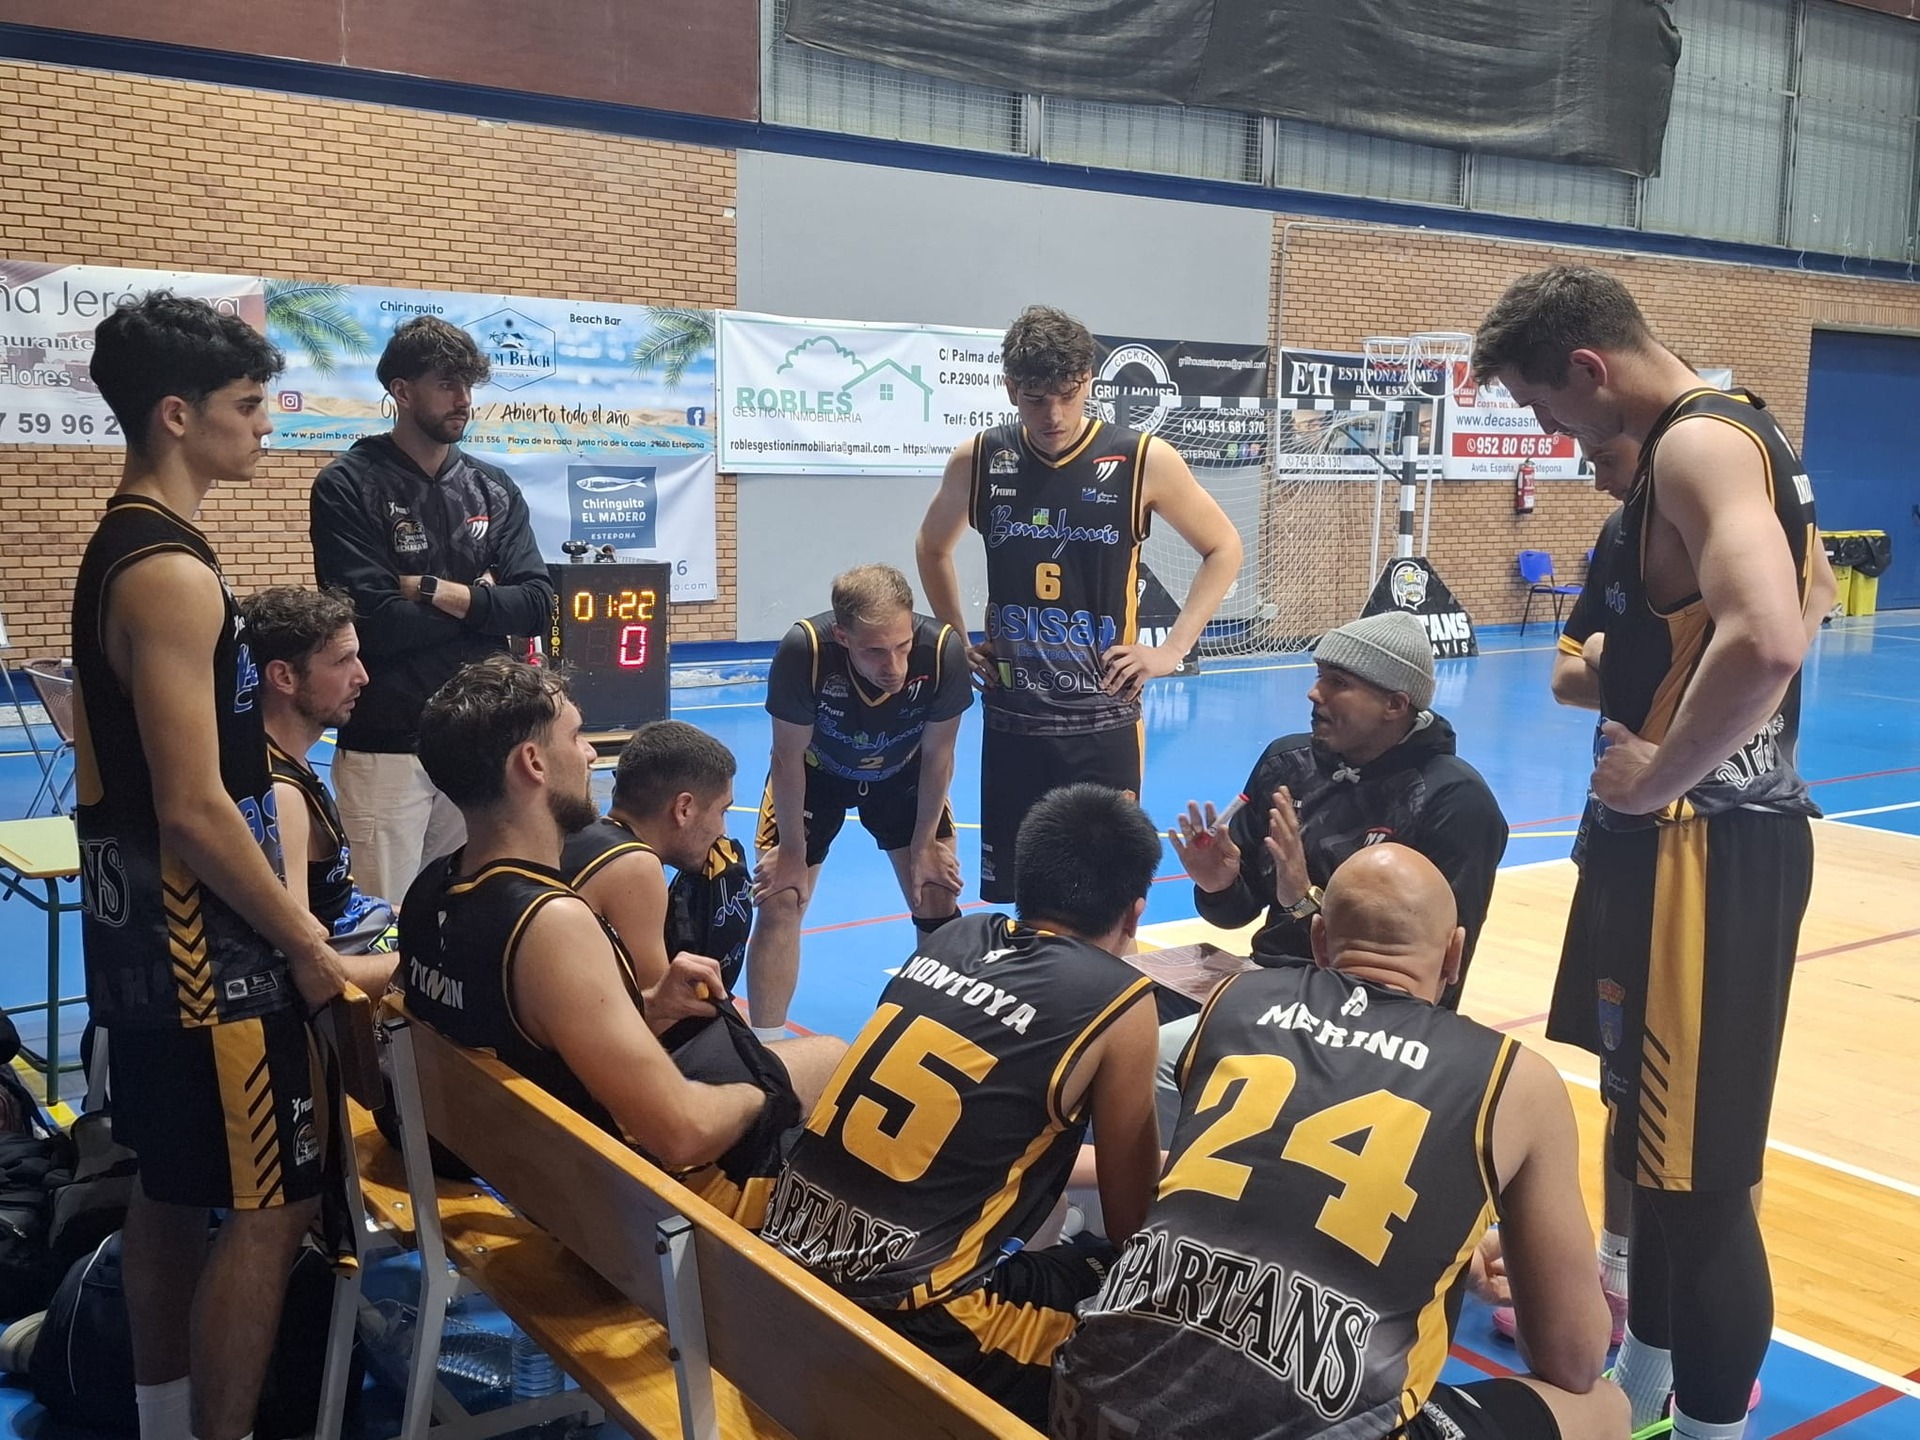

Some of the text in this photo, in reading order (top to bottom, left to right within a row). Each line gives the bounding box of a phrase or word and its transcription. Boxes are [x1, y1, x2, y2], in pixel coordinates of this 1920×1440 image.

[380, 300, 444, 315] Chiringuito
[569, 313, 622, 327] Beach Bar
[952, 349, 984, 363] Palma
[1114, 350, 1157, 371] COCKTAIL
[939, 371, 990, 386] C.P.29004
[736, 387, 853, 415] ROBLES
[501, 402, 556, 424] Abierto
[560, 402, 588, 425] todo
[592, 403, 602, 422] el
[606, 410, 630, 428] año
[732, 406, 862, 423] GESTION INMOBILIARIA
[943, 413, 967, 425] Telf:
[969, 411, 993, 427] 615
[18, 413, 51, 434] 59
[62, 413, 94, 434] 96
[1208, 422, 1226, 433] 951
[1228, 422, 1246, 433] 681
[1248, 422, 1265, 433] 370
[507, 437, 530, 445] Playa
[730, 438, 891, 455] roblesgestioninmobiliaria@gmail.com
[1476, 437, 1552, 455] 952 80 65 65
[1535, 464, 1562, 474] stepona
[583, 498, 645, 511] Chiringuito
[582, 511, 646, 523] EL MADERO
[591, 532, 636, 540] ESTEPONA
[1035, 562, 1062, 601] 6
[620, 625, 648, 666] 0
[899, 956, 1038, 1036] MONTOYA
[1256, 1003, 1431, 1071] MERINO
[806, 1002, 999, 1184] 15
[1156, 1054, 1432, 1267] 24
